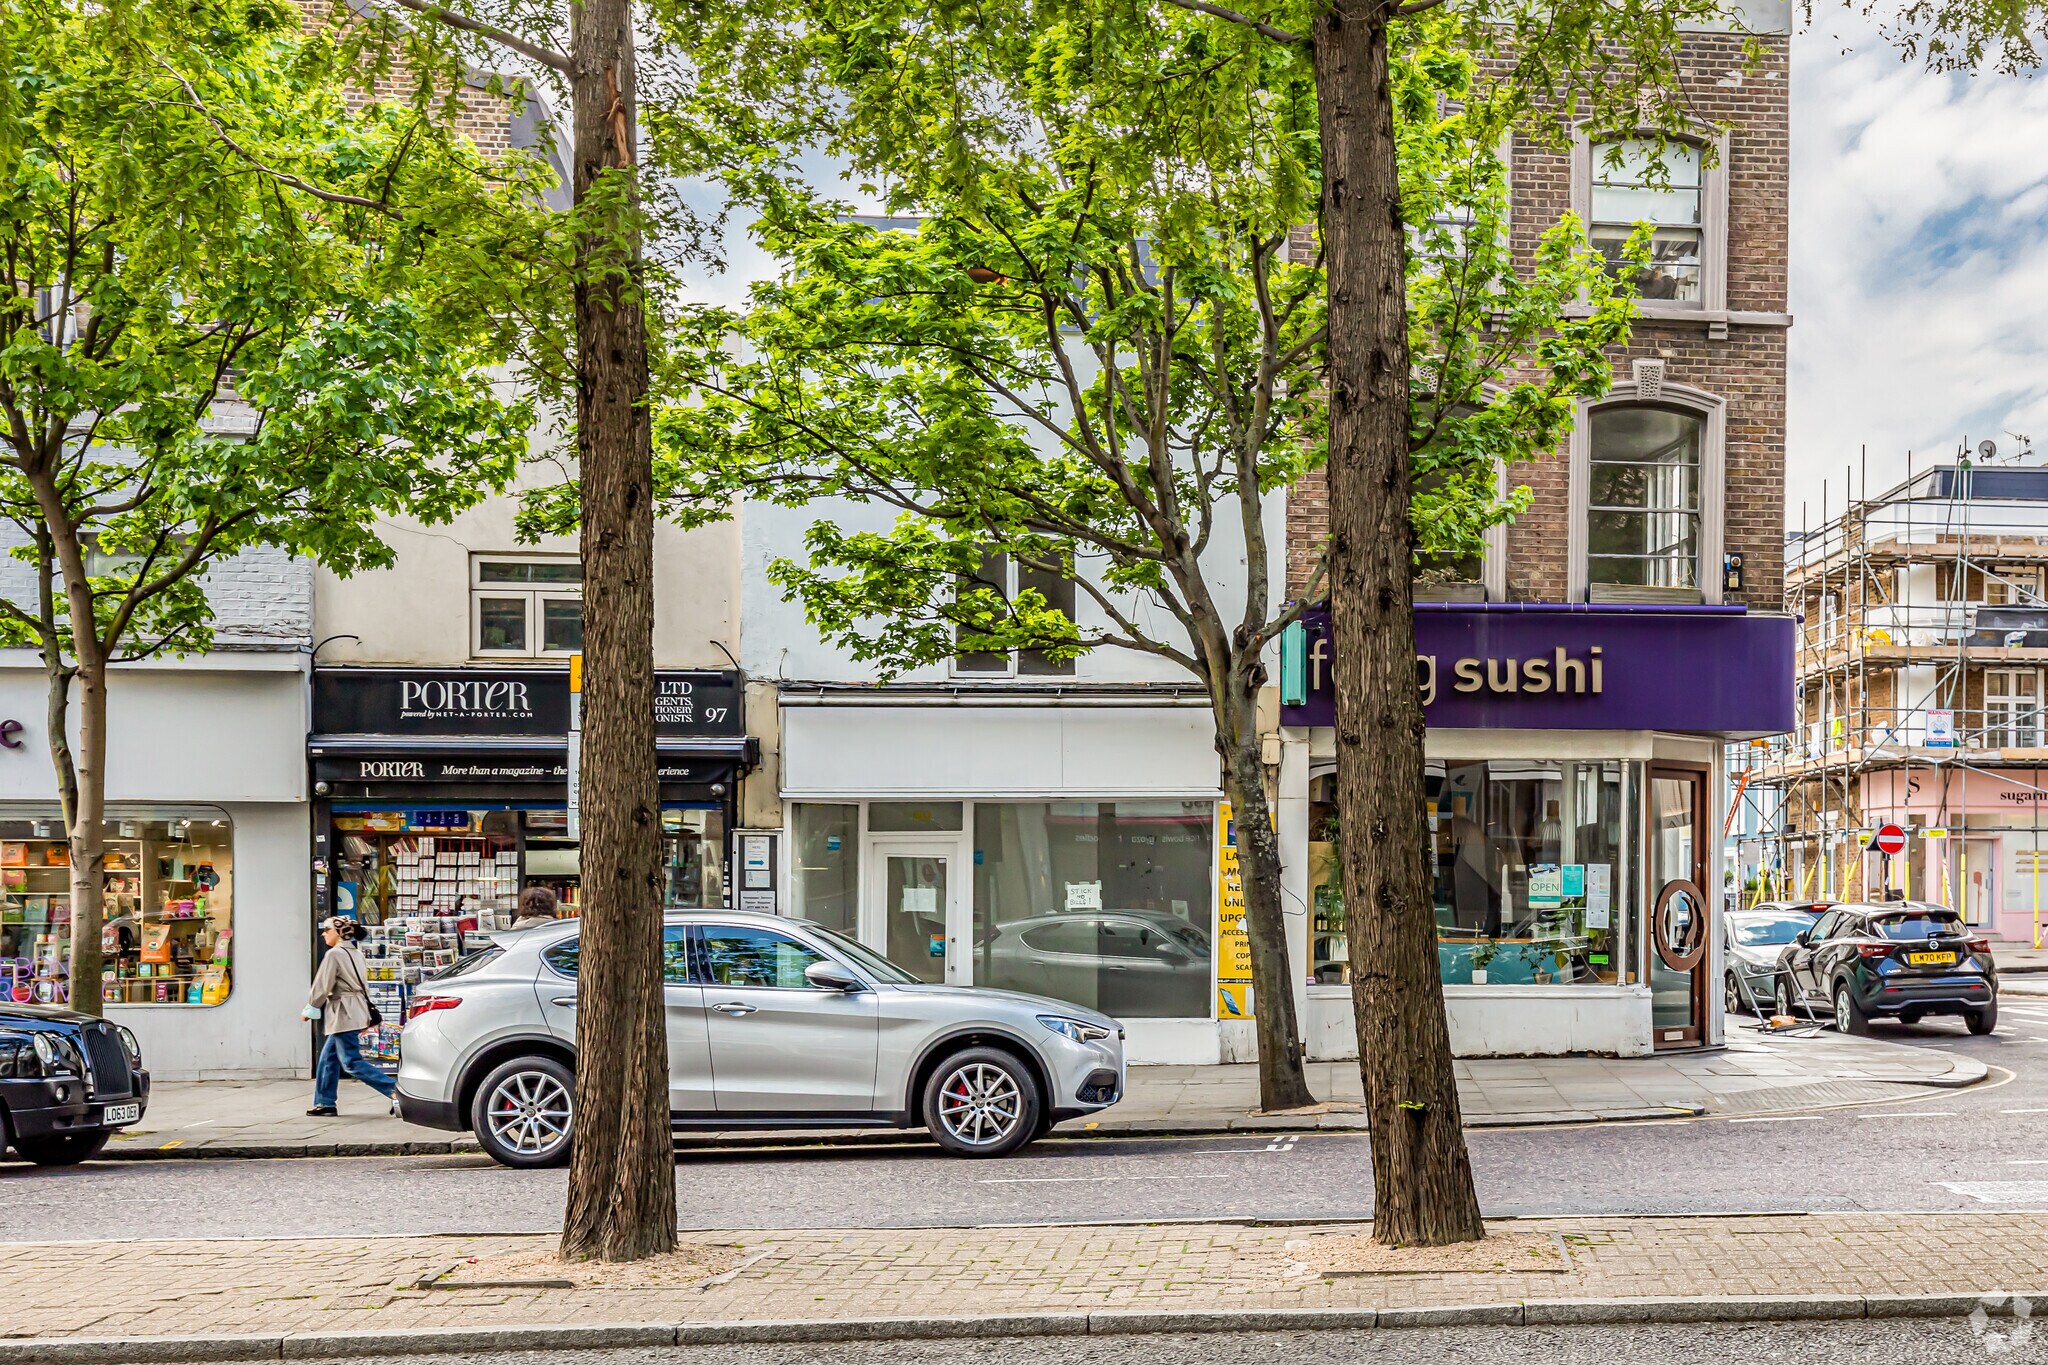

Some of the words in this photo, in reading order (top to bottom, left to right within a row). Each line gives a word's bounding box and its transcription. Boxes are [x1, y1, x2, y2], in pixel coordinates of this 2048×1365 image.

[1309, 639, 1436, 706] fg
[1453, 646, 1603, 694] sushi
[660, 681, 693, 695] LTD
[655, 696, 694, 707] GENTS,
[400, 710, 427, 719] powered
[427, 710, 435, 719] by
[655, 706, 694, 714] TIONERY
[705, 707, 727, 723] 97
[441, 765, 467, 775] More
[469, 765, 490, 775] than
[499, 766, 543, 777] magazine
[553, 765, 568, 775] the
[657, 766, 690, 776] erience
[1531, 882, 1559, 892] OPEN
